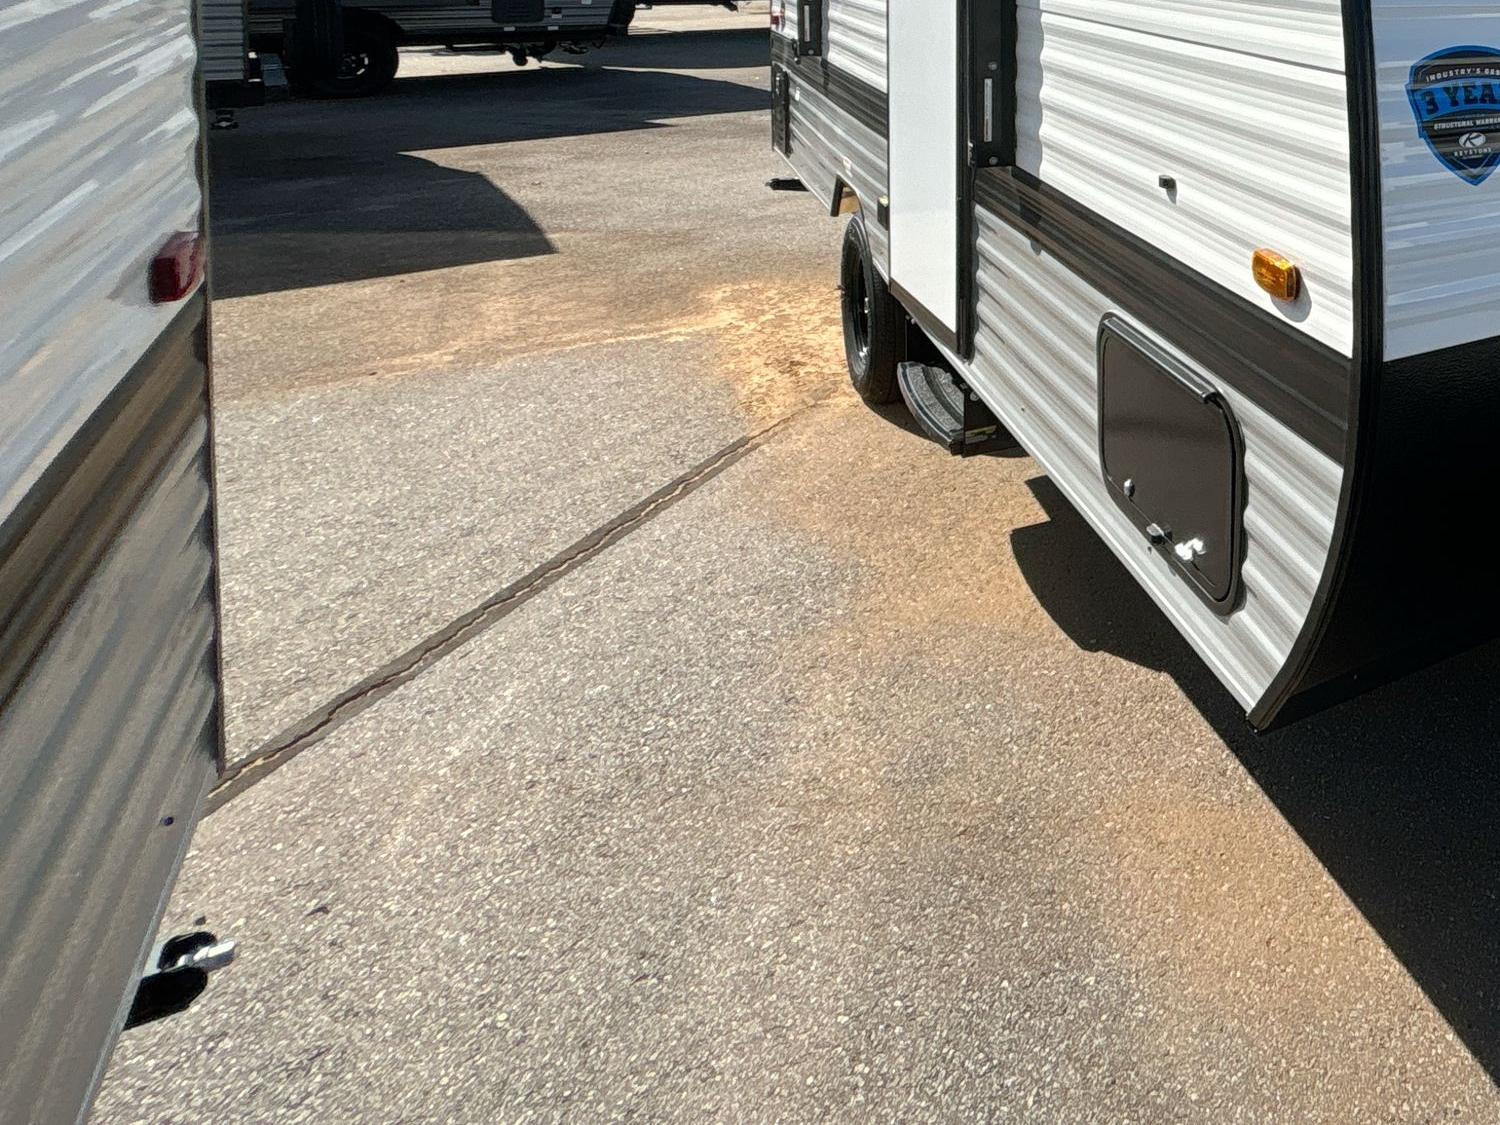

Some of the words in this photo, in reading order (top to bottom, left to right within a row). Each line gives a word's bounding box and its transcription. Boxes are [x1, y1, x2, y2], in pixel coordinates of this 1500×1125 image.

[1426, 68, 1481, 82] INDUSTRY'S
[1421, 91, 1439, 114] 3
[1434, 120, 1474, 130] STRUCTURAL
[1453, 147, 1492, 157] KEYSTONE
